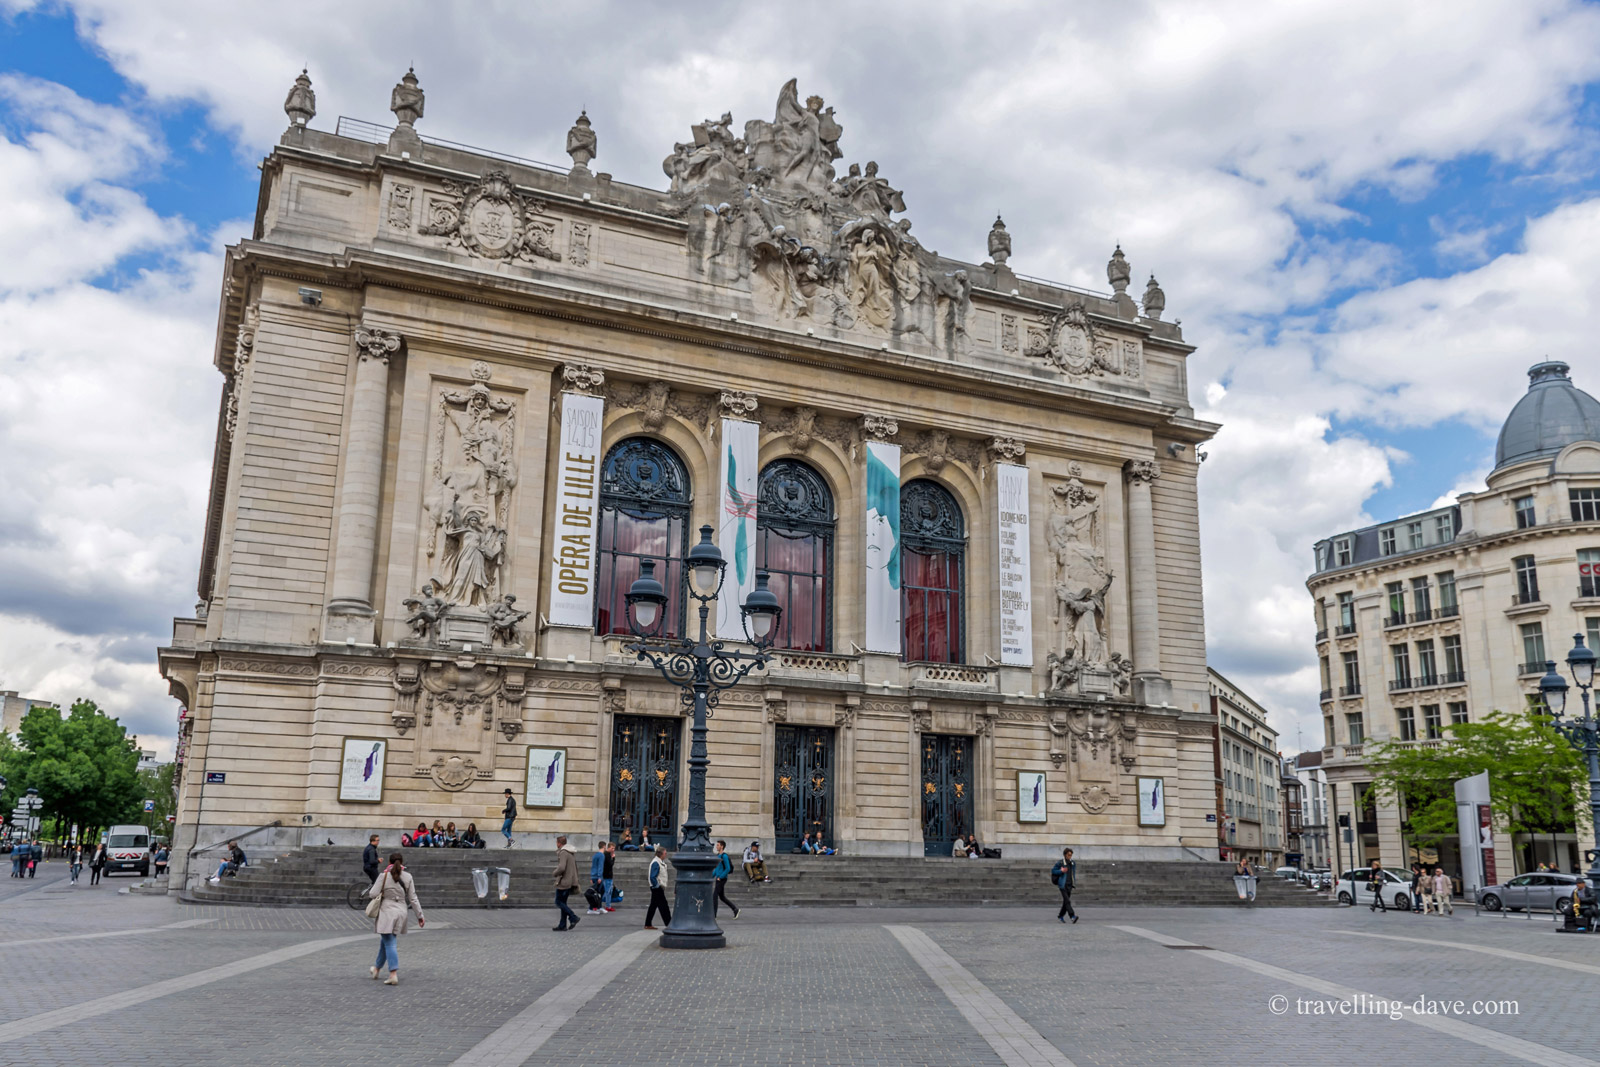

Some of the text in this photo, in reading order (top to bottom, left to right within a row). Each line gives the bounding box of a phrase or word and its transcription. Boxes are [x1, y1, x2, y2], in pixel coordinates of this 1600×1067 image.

[566, 408, 598, 428] SAISON
[566, 425, 595, 448] 14.15
[564, 452, 595, 499] LILLE
[562, 503, 592, 528] DE
[1001, 511, 1027, 525] IDOMENEO
[552, 535, 591, 595] OPÉRA
[1002, 599, 1029, 611] BUTTERFLY
